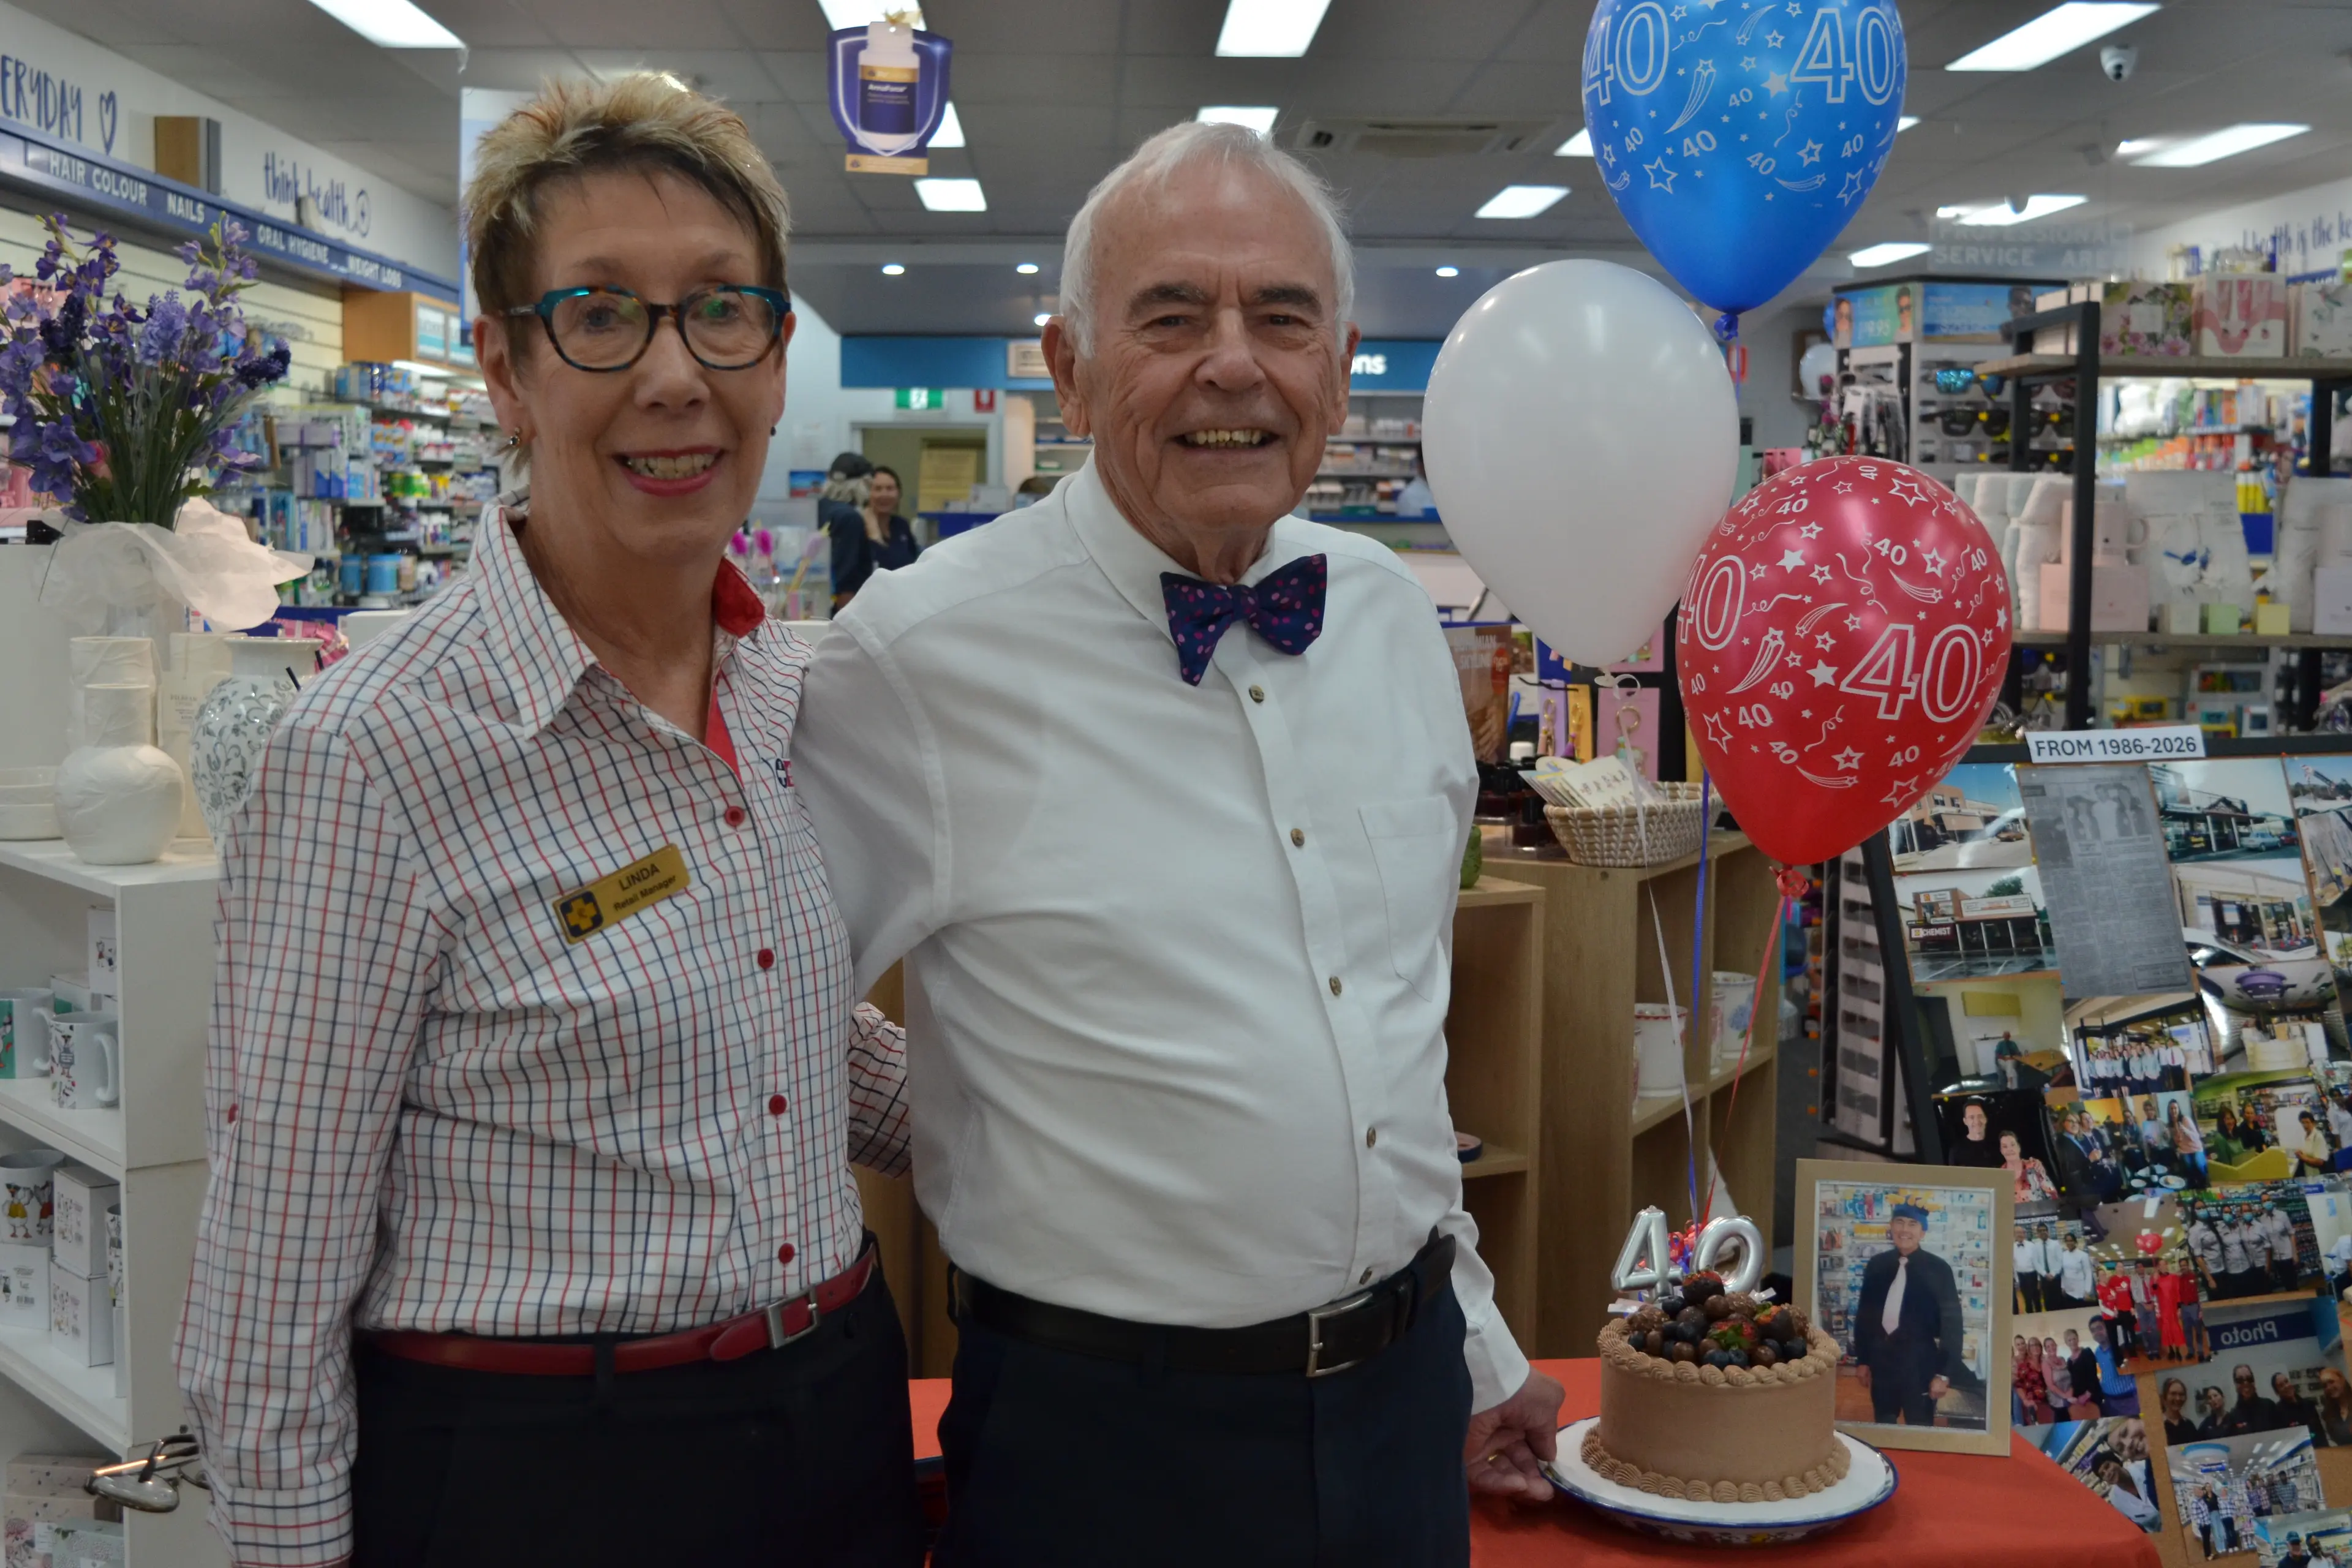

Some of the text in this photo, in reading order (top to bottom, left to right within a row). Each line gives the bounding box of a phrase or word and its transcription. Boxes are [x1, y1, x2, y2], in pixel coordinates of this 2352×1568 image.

[1585, 1, 1669, 106] 40
[1790, 7, 1897, 105] 40
[1, 54, 82, 142] ERYDAY
[1728, 88, 1753, 108] 40
[1625, 127, 1643, 153] 40
[1682, 130, 1717, 159] 40
[1841, 134, 1864, 159] 40
[1746, 152, 1776, 176] 40
[50, 152, 147, 206] HAIR COLOUR
[167, 192, 205, 224] NAILS
[257, 224, 329, 265] ORAL HYGIENE
[1934, 245, 2036, 268] SERVICE
[1351, 353, 1387, 375] ns
[1858, 466, 1878, 480] 40
[1776, 499, 1808, 514] 40
[1874, 538, 1907, 565] 40
[1970, 548, 1988, 572] 40
[1677, 554, 1746, 651] 40
[1691, 673, 1706, 695] 40
[1839, 623, 1981, 723] 40
[1769, 680, 1793, 697] 40
[1738, 703, 1772, 729] 40
[1769, 741, 1798, 764] 40
[1888, 745, 1920, 767] 40
[2035, 736, 2196, 756] FROM 1986-2026
[619, 863, 661, 891] LINDA
[614, 875, 676, 911] Retail Manager
[1923, 926, 1951, 937] CHEMIST
[1611, 1206, 1764, 1301] 40
